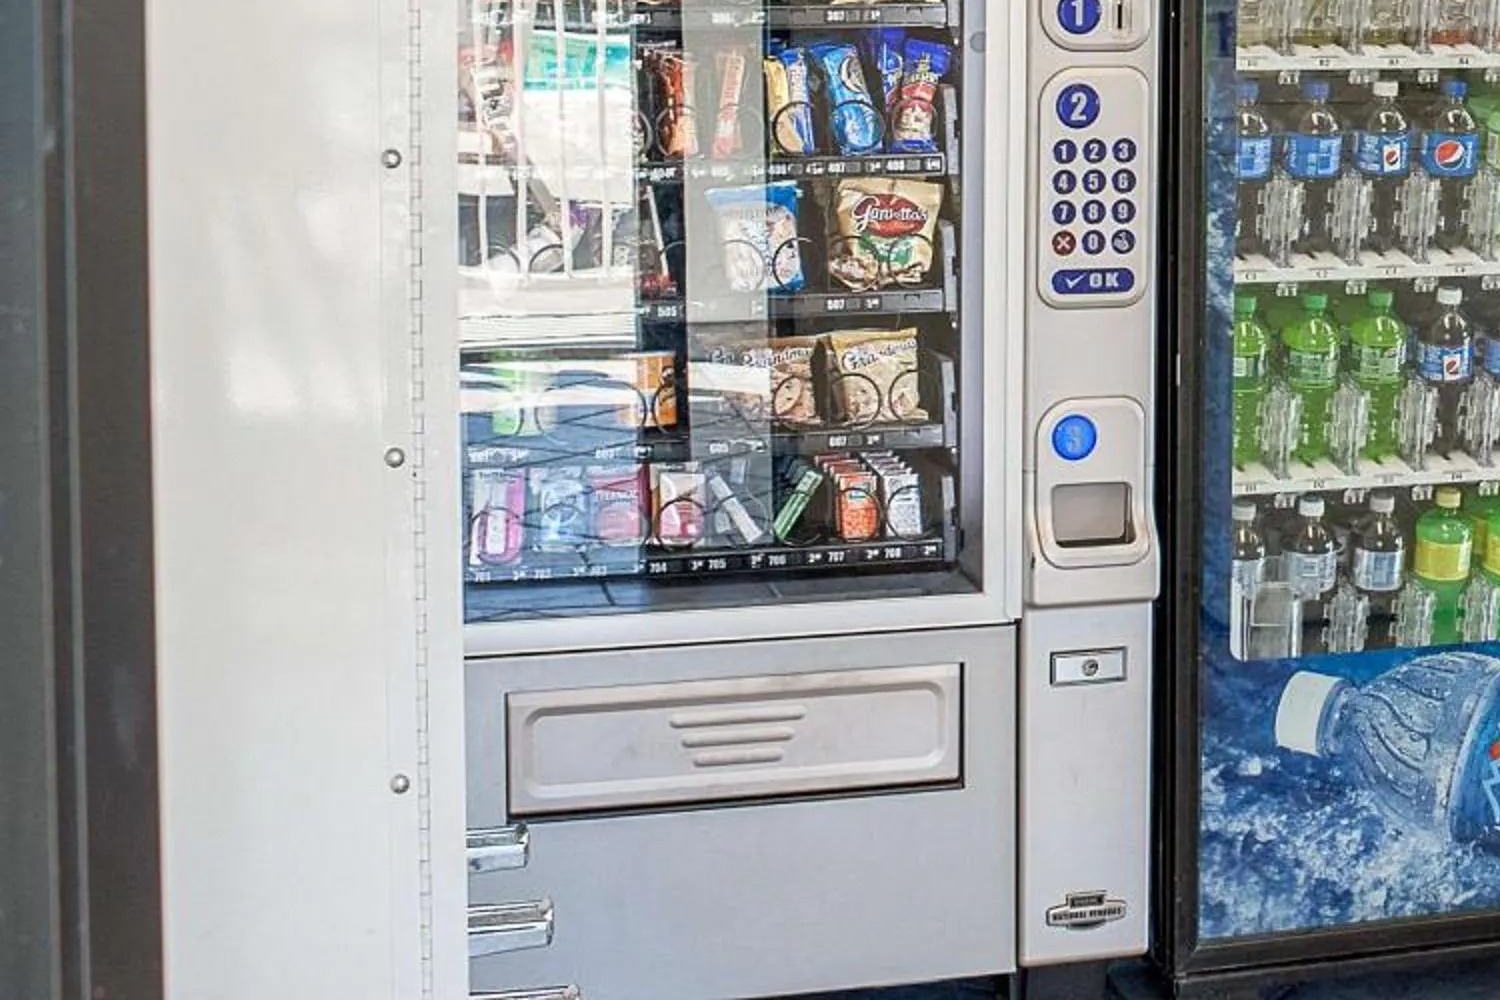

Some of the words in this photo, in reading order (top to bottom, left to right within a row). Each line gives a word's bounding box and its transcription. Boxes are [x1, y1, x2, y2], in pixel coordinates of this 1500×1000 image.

[1070, 92, 1087, 121] 2
[1059, 143, 1068, 160] 1
[1089, 143, 1099, 160] 2
[1119, 143, 1129, 159] 3
[1058, 174, 1069, 190] 4
[1088, 173, 1099, 190] 5
[1118, 173, 1128, 190] 6
[1059, 204, 1069, 221] 7
[1088, 204, 1098, 220] 8
[1118, 203, 1128, 220] 9
[1088, 233, 1098, 250] 0
[1089, 271, 1120, 288] OK
